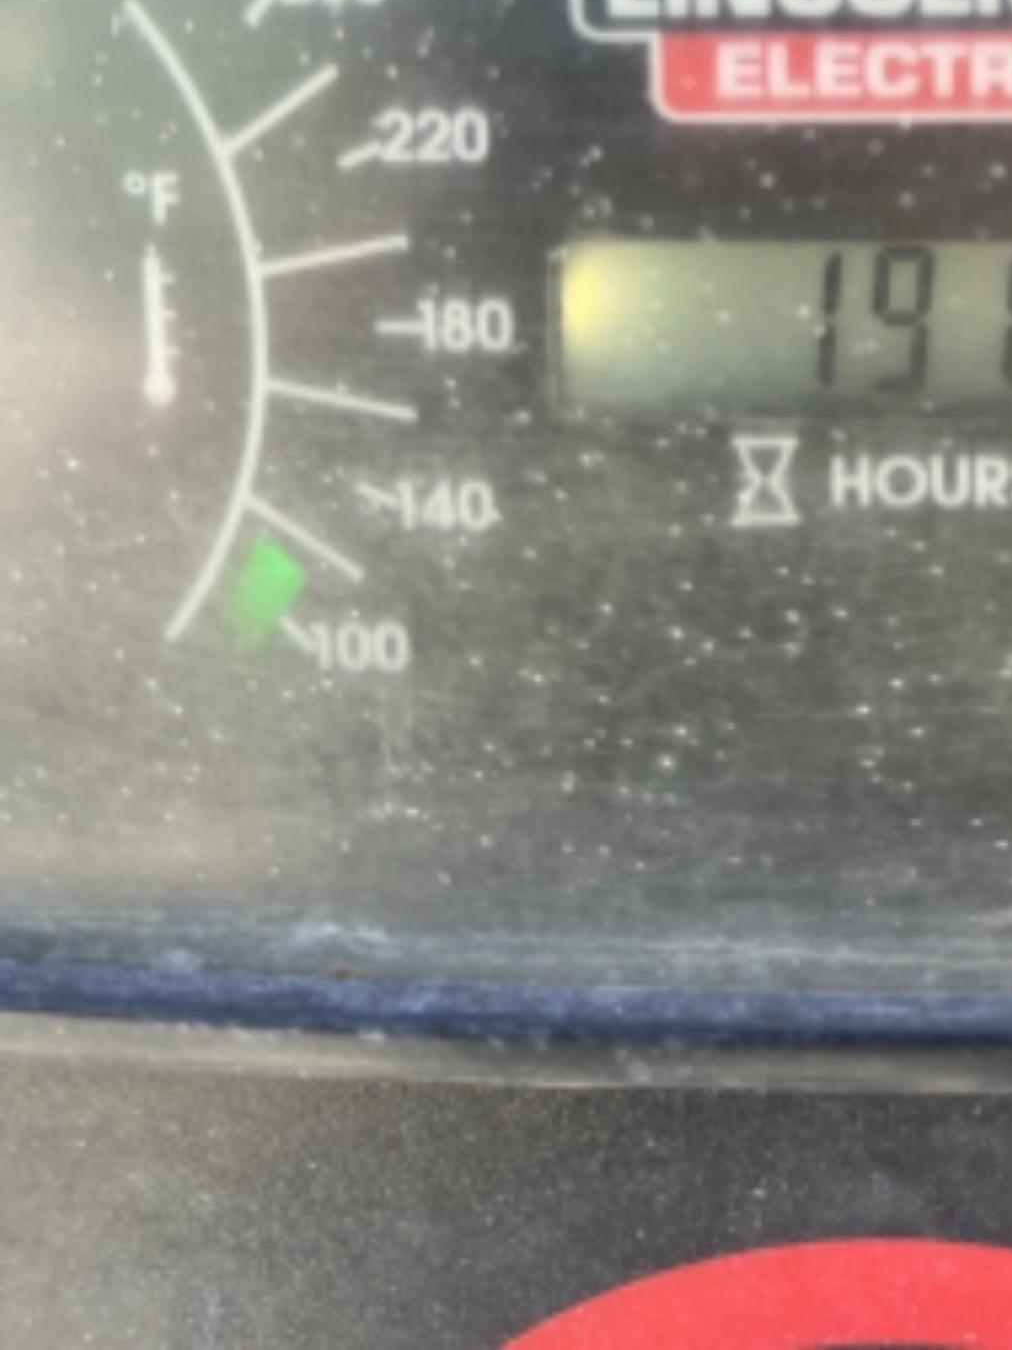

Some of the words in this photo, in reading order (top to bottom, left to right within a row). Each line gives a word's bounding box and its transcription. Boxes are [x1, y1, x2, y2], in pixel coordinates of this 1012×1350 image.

[378, 109, 491, 163] 220
[415, 298, 514, 352] 180
[396, 479, 495, 532] 140
[309, 621, 410, 673] 100
